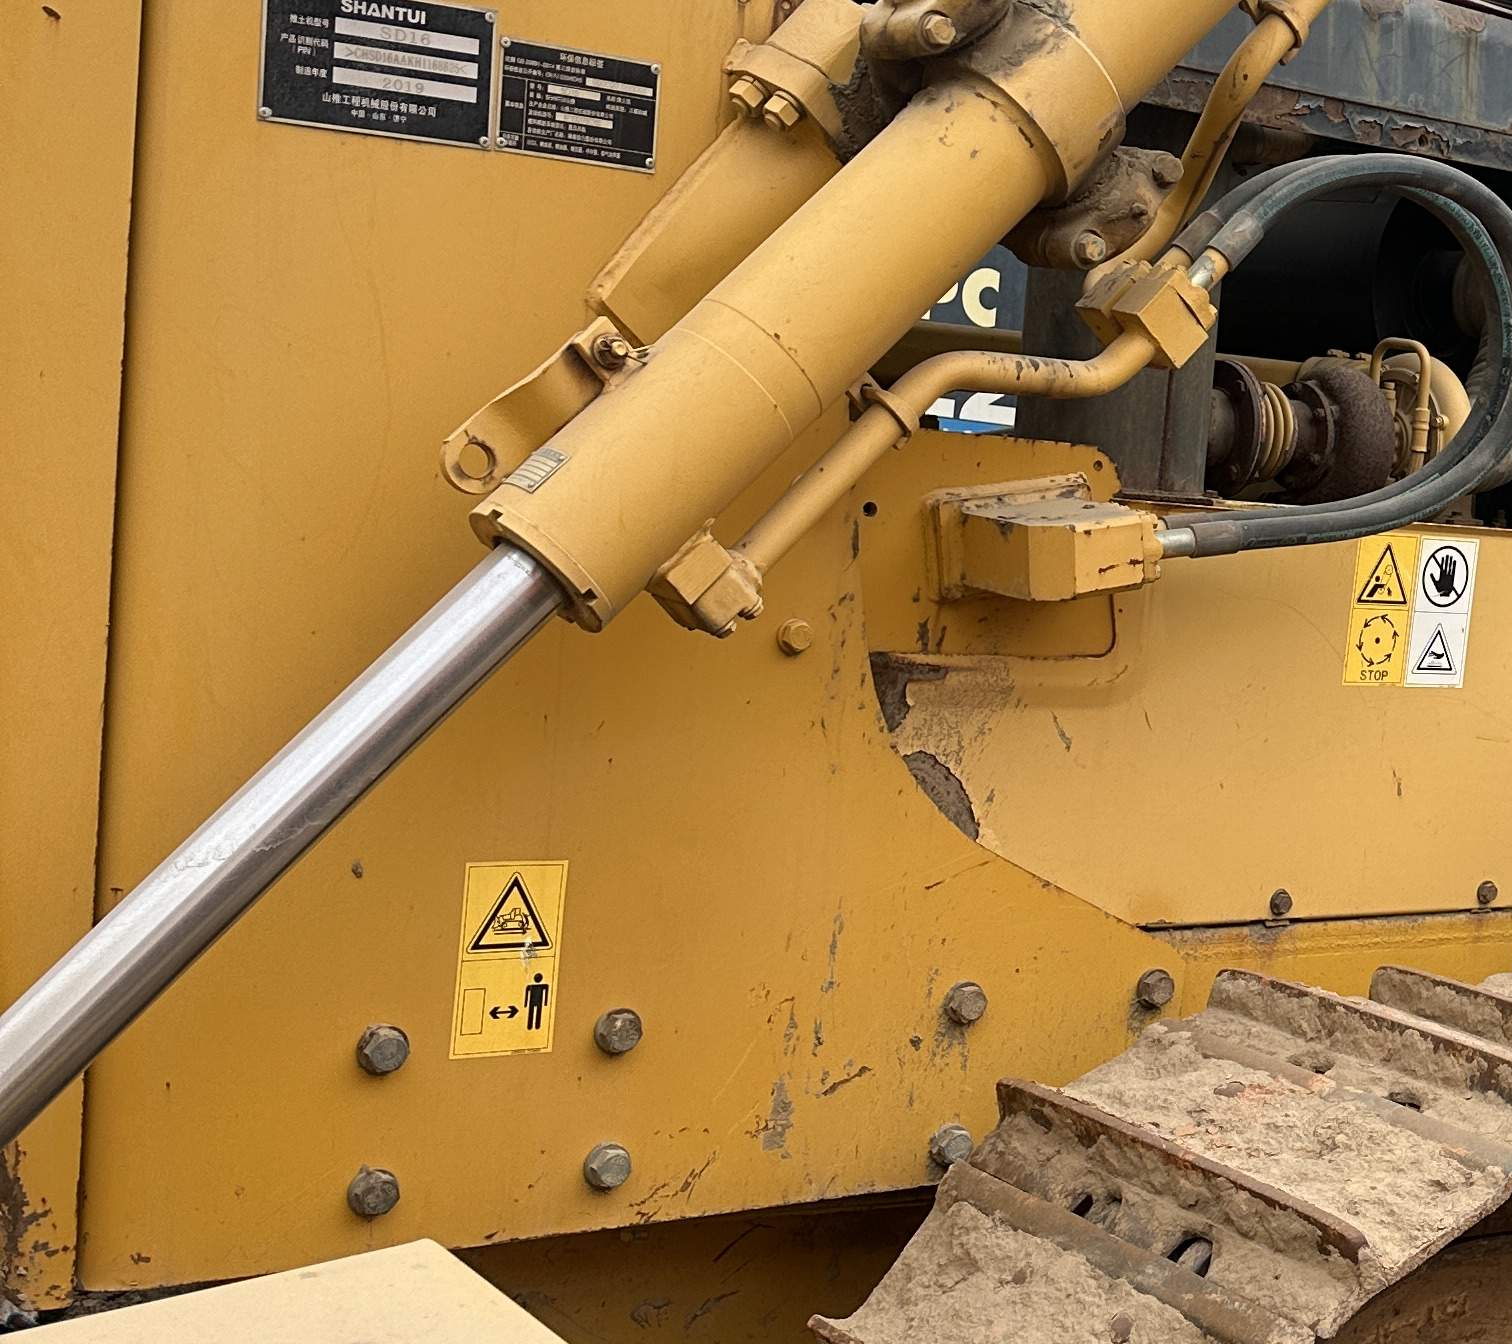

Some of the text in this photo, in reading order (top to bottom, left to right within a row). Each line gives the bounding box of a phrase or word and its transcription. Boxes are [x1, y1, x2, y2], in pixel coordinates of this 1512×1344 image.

[380, 26, 431, 46] SD16
[382, 77, 425, 94] 2019
[1360, 669, 1389, 681] STOP
